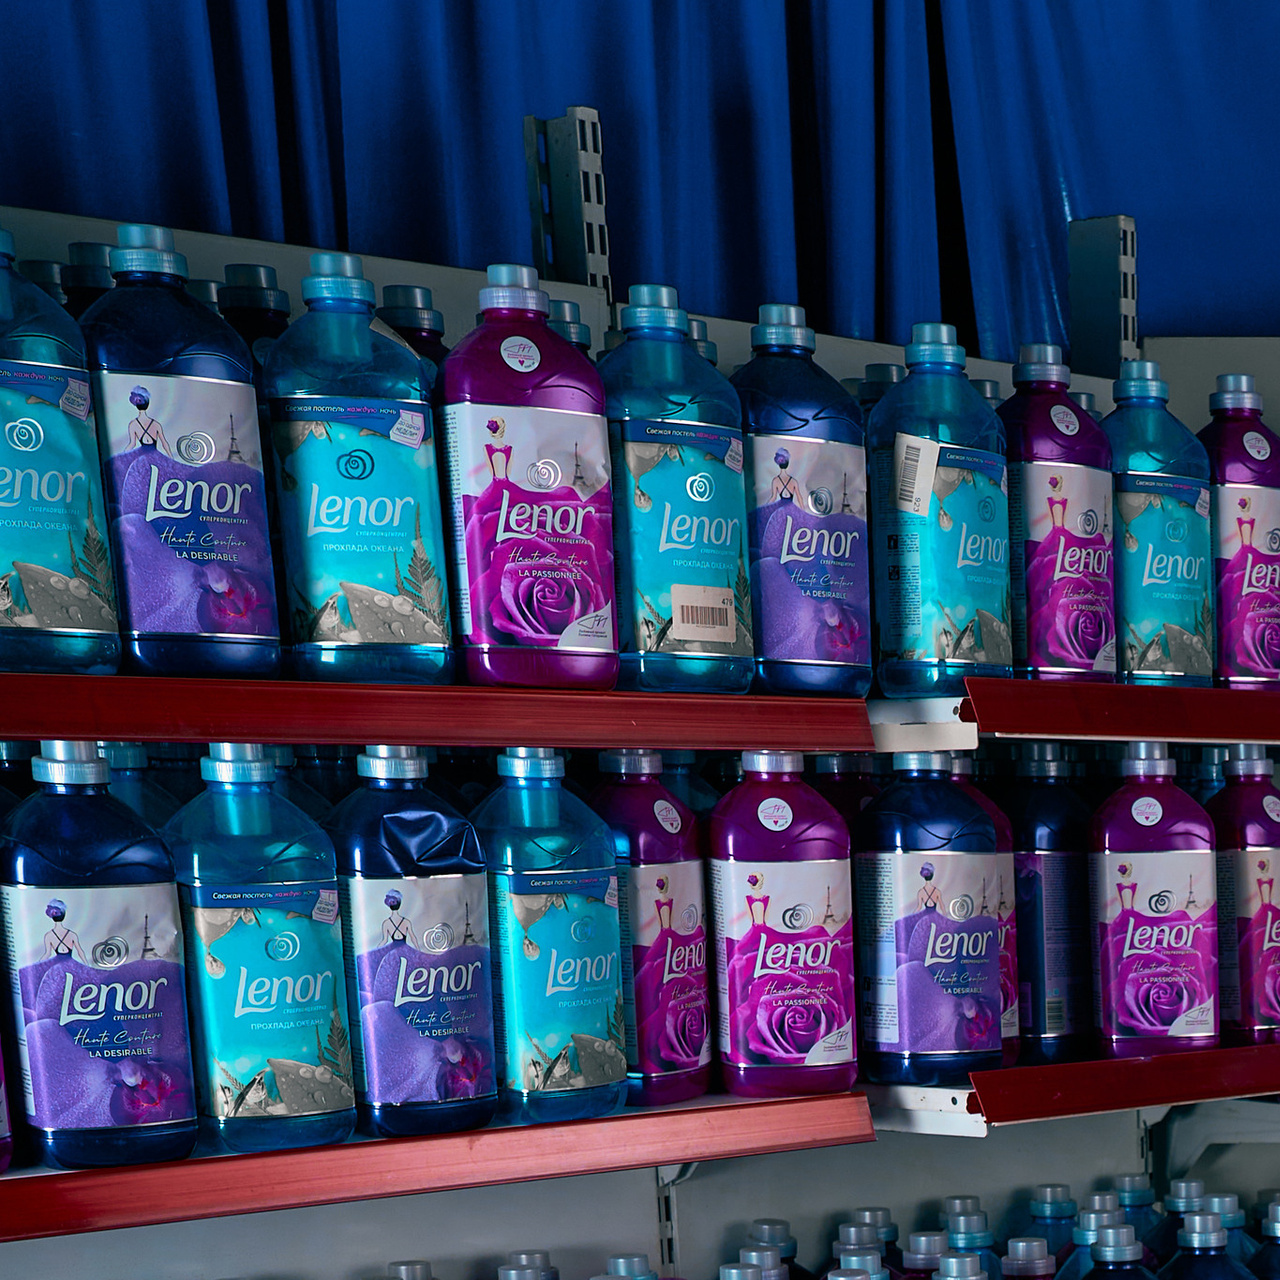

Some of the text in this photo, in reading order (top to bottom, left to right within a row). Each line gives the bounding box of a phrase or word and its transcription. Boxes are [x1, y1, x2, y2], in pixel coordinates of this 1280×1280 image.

[0, 466, 85, 507] enor
[145, 464, 252, 522] Lenor
[307, 483, 414, 537] Lenor
[496, 489, 595, 543] Lenor
[658, 501, 739, 553] Lenor
[175, 550, 239, 563] LA DESIRABLE
[370, 544, 405, 553] ОКЕАНА
[780, 514, 860, 565] Lenor
[957, 522, 1007, 568] Lenor
[1053, 535, 1112, 581] Lenor
[518, 569, 530, 577] LA
[1142, 543, 1205, 588] Lenor
[753, 932, 841, 979] Lenor
[923, 922, 993, 968] Lenor
[1122, 916, 1203, 958] Lenor
[234, 966, 332, 1019] Lenor
[393, 956, 482, 1008] Lenor
[545, 948, 617, 997] Lenor
[59, 971, 168, 1026] Lenor
[772, 998, 783, 1007] LA
[89, 1047, 153, 1059] LA DESIRABLE
[419, 1027, 470, 1037] LA DESIRABLE
